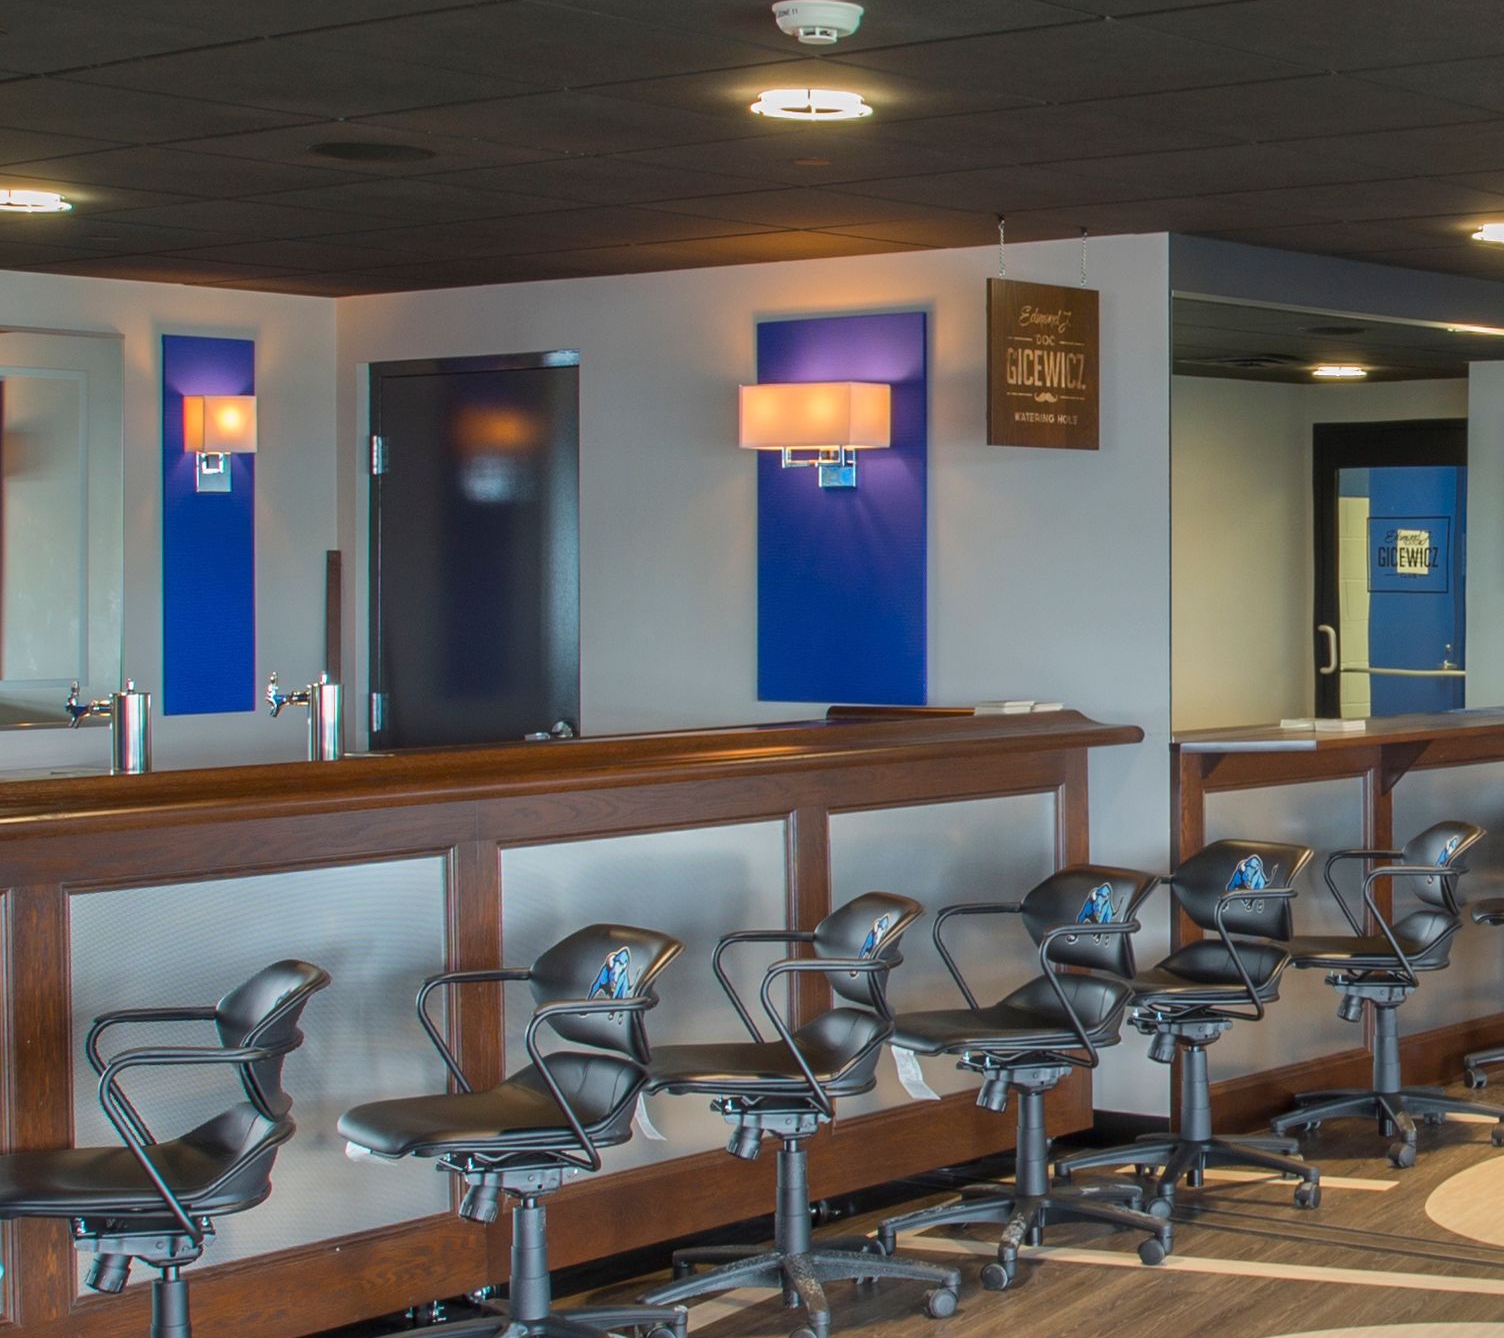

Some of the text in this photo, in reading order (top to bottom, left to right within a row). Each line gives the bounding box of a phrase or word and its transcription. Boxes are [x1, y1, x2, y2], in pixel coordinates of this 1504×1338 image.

[1007, 347, 1086, 390] GICEWICZ
[1014, 412, 1055, 424] WATERING
[1378, 547, 1439, 568] GICEWICZ
